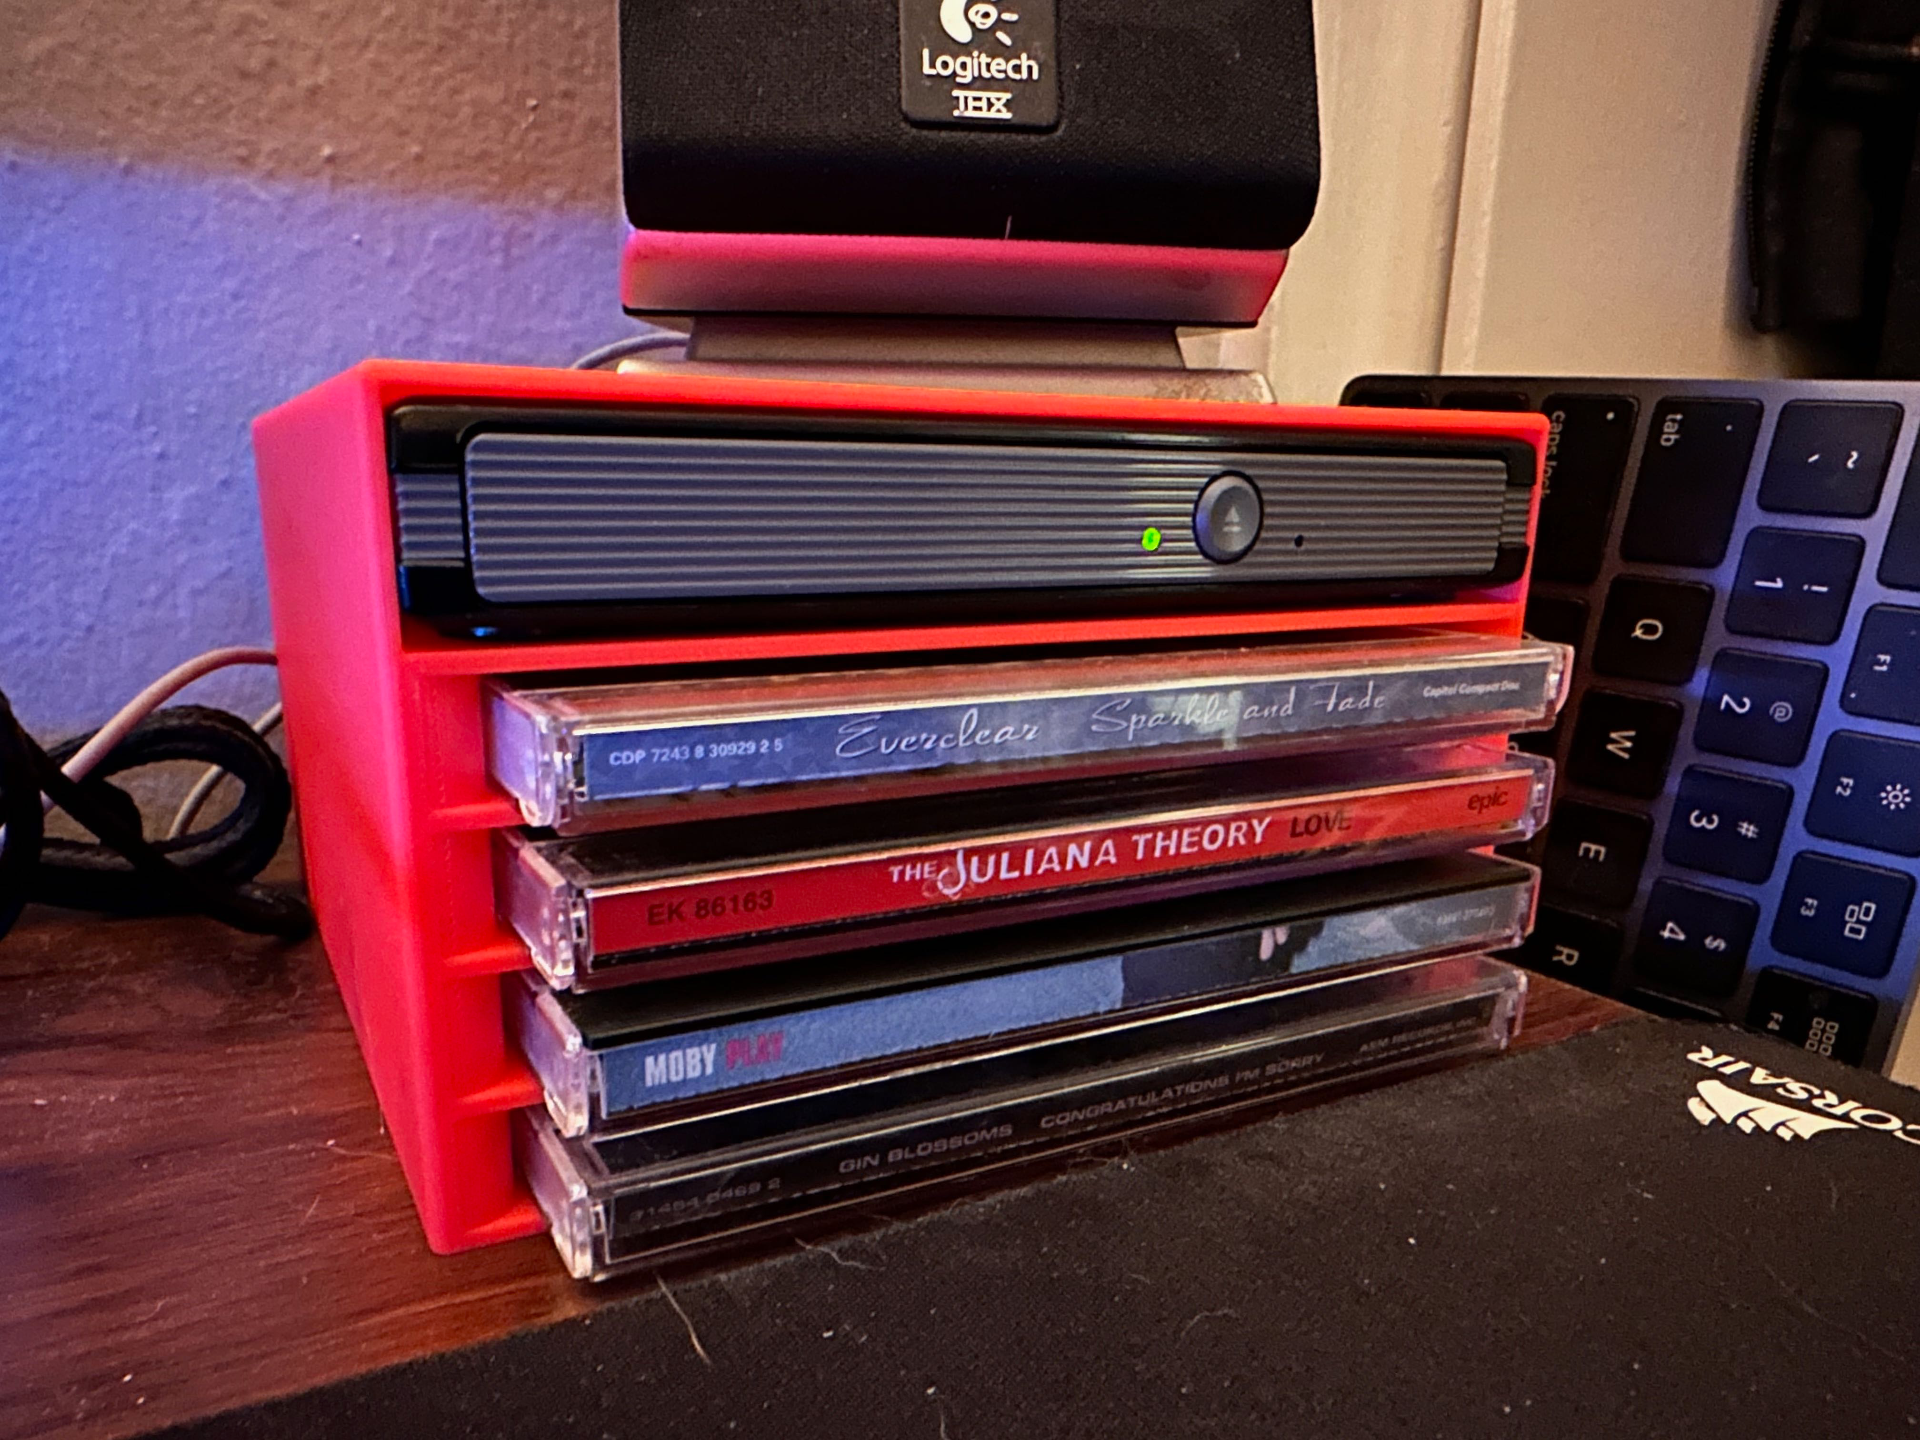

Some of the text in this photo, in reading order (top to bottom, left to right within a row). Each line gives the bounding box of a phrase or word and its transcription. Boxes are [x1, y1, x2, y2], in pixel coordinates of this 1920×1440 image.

[922, 48, 1039, 84] Logitech
[951, 89, 1013, 119] THX
[1660, 413, 1683, 447] tab
[1754, 577, 1784, 589] 1
[1803, 584, 1829, 592] !
[1631, 618, 1663, 640] Q
[1873, 654, 1891, 672] F1
[1720, 694, 1751, 716] 2
[1769, 701, 1793, 723] @
[835, 681, 1387, 758] Everclear Sparkle and Fade
[609, 750, 646, 766] CDP
[651, 746, 690, 763] 7243
[709, 741, 756, 758] 30929
[760, 739, 770, 754] 2
[1606, 730, 1636, 760] W
[1835, 776, 1854, 797] F2
[1467, 786, 1508, 815] epic
[1689, 809, 1719, 831] 3
[1737, 820, 1760, 840] #
[890, 807, 1353, 898] THE JULIANA THEORY LOVE
[1578, 841, 1606, 862] E
[647, 888, 775, 926] EK 86163
[1800, 897, 1818, 918] F3
[1659, 921, 1687, 943] 4
[1704, 934, 1727, 953] $
[1552, 944, 1580, 967] R
[1766, 1011, 1783, 1031] F4
[645, 1030, 785, 1087] MOBY PLAY
[839, 1052, 1327, 1175] GIN BLOSSOMS CONGRATULATIONS I'M SORRY
